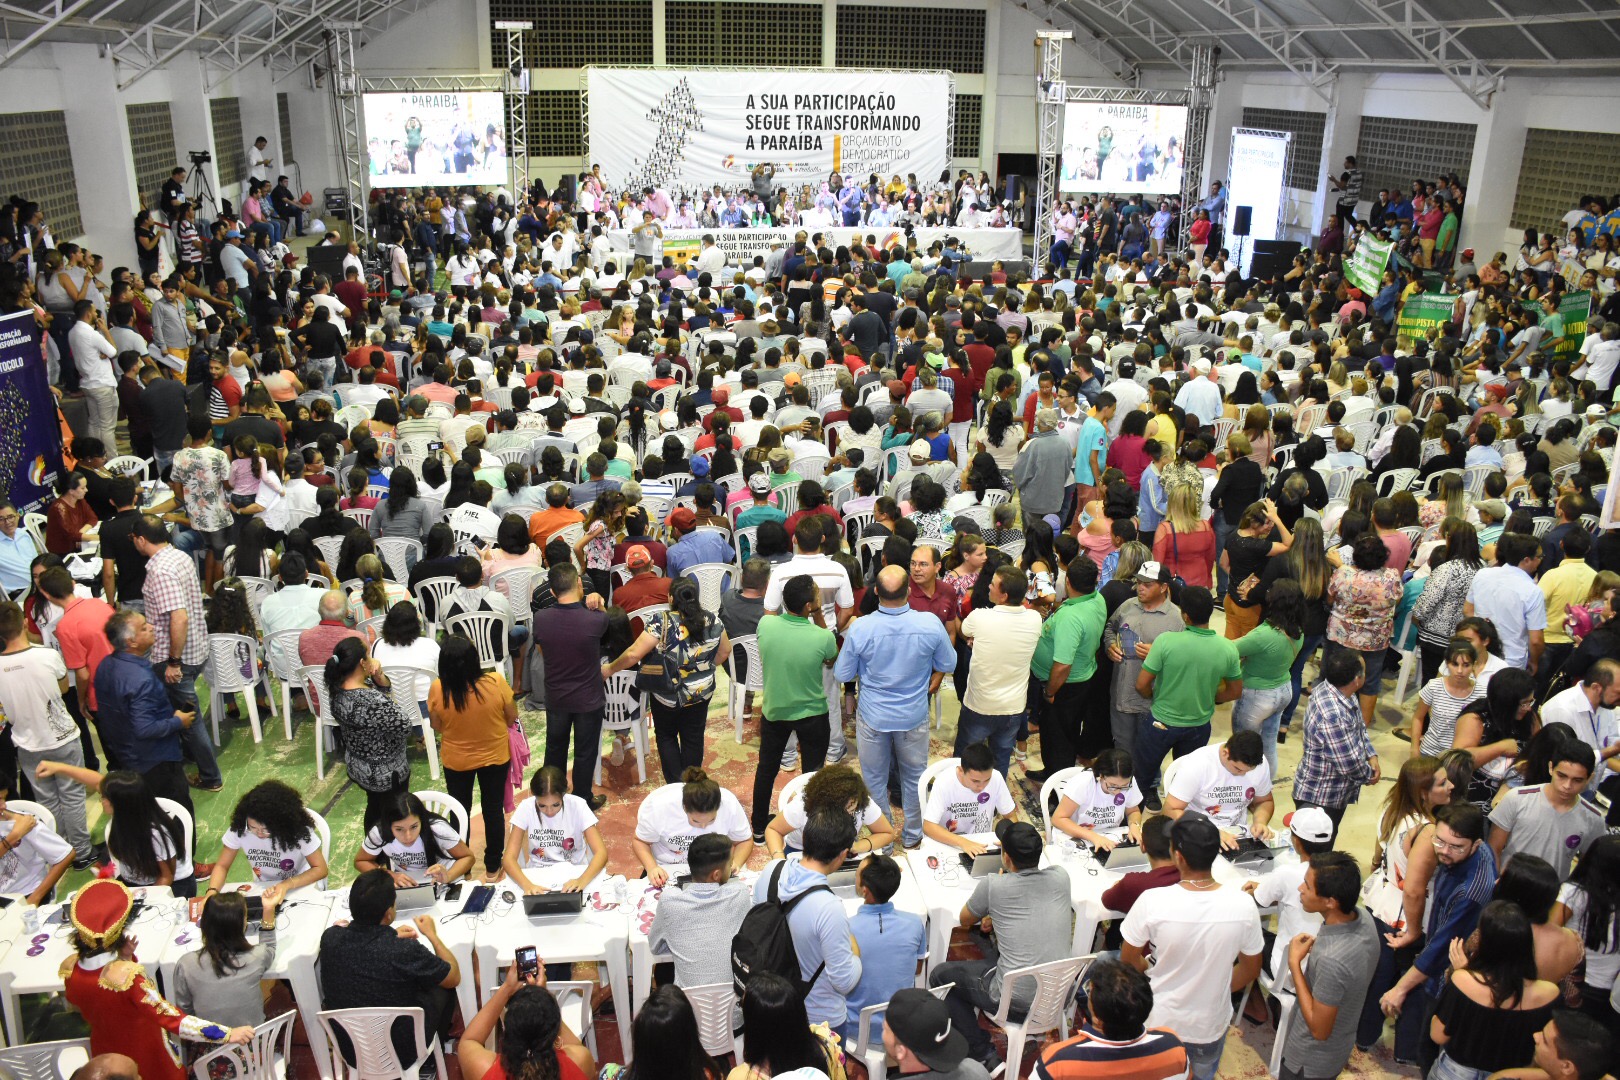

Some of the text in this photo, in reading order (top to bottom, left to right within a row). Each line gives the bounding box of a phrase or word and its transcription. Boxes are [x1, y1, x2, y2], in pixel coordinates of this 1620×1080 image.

[746, 92, 896, 114] A SUA PARTICIPAÇÃO
[746, 114, 920, 131] SEGUE TRANSFORMANDO
[746, 132, 823, 150] A PARAÍBA
[842, 135, 902, 148] ORÇAMENTO
[868, 162, 890, 174] AQUI
[716, 234, 720, 242] A
[722, 234, 736, 242] SUA
[716, 242, 737, 250] SEGUE
[464, 510, 479, 520] FIEL
[248, 848, 280, 858] ORÇAMENTO
